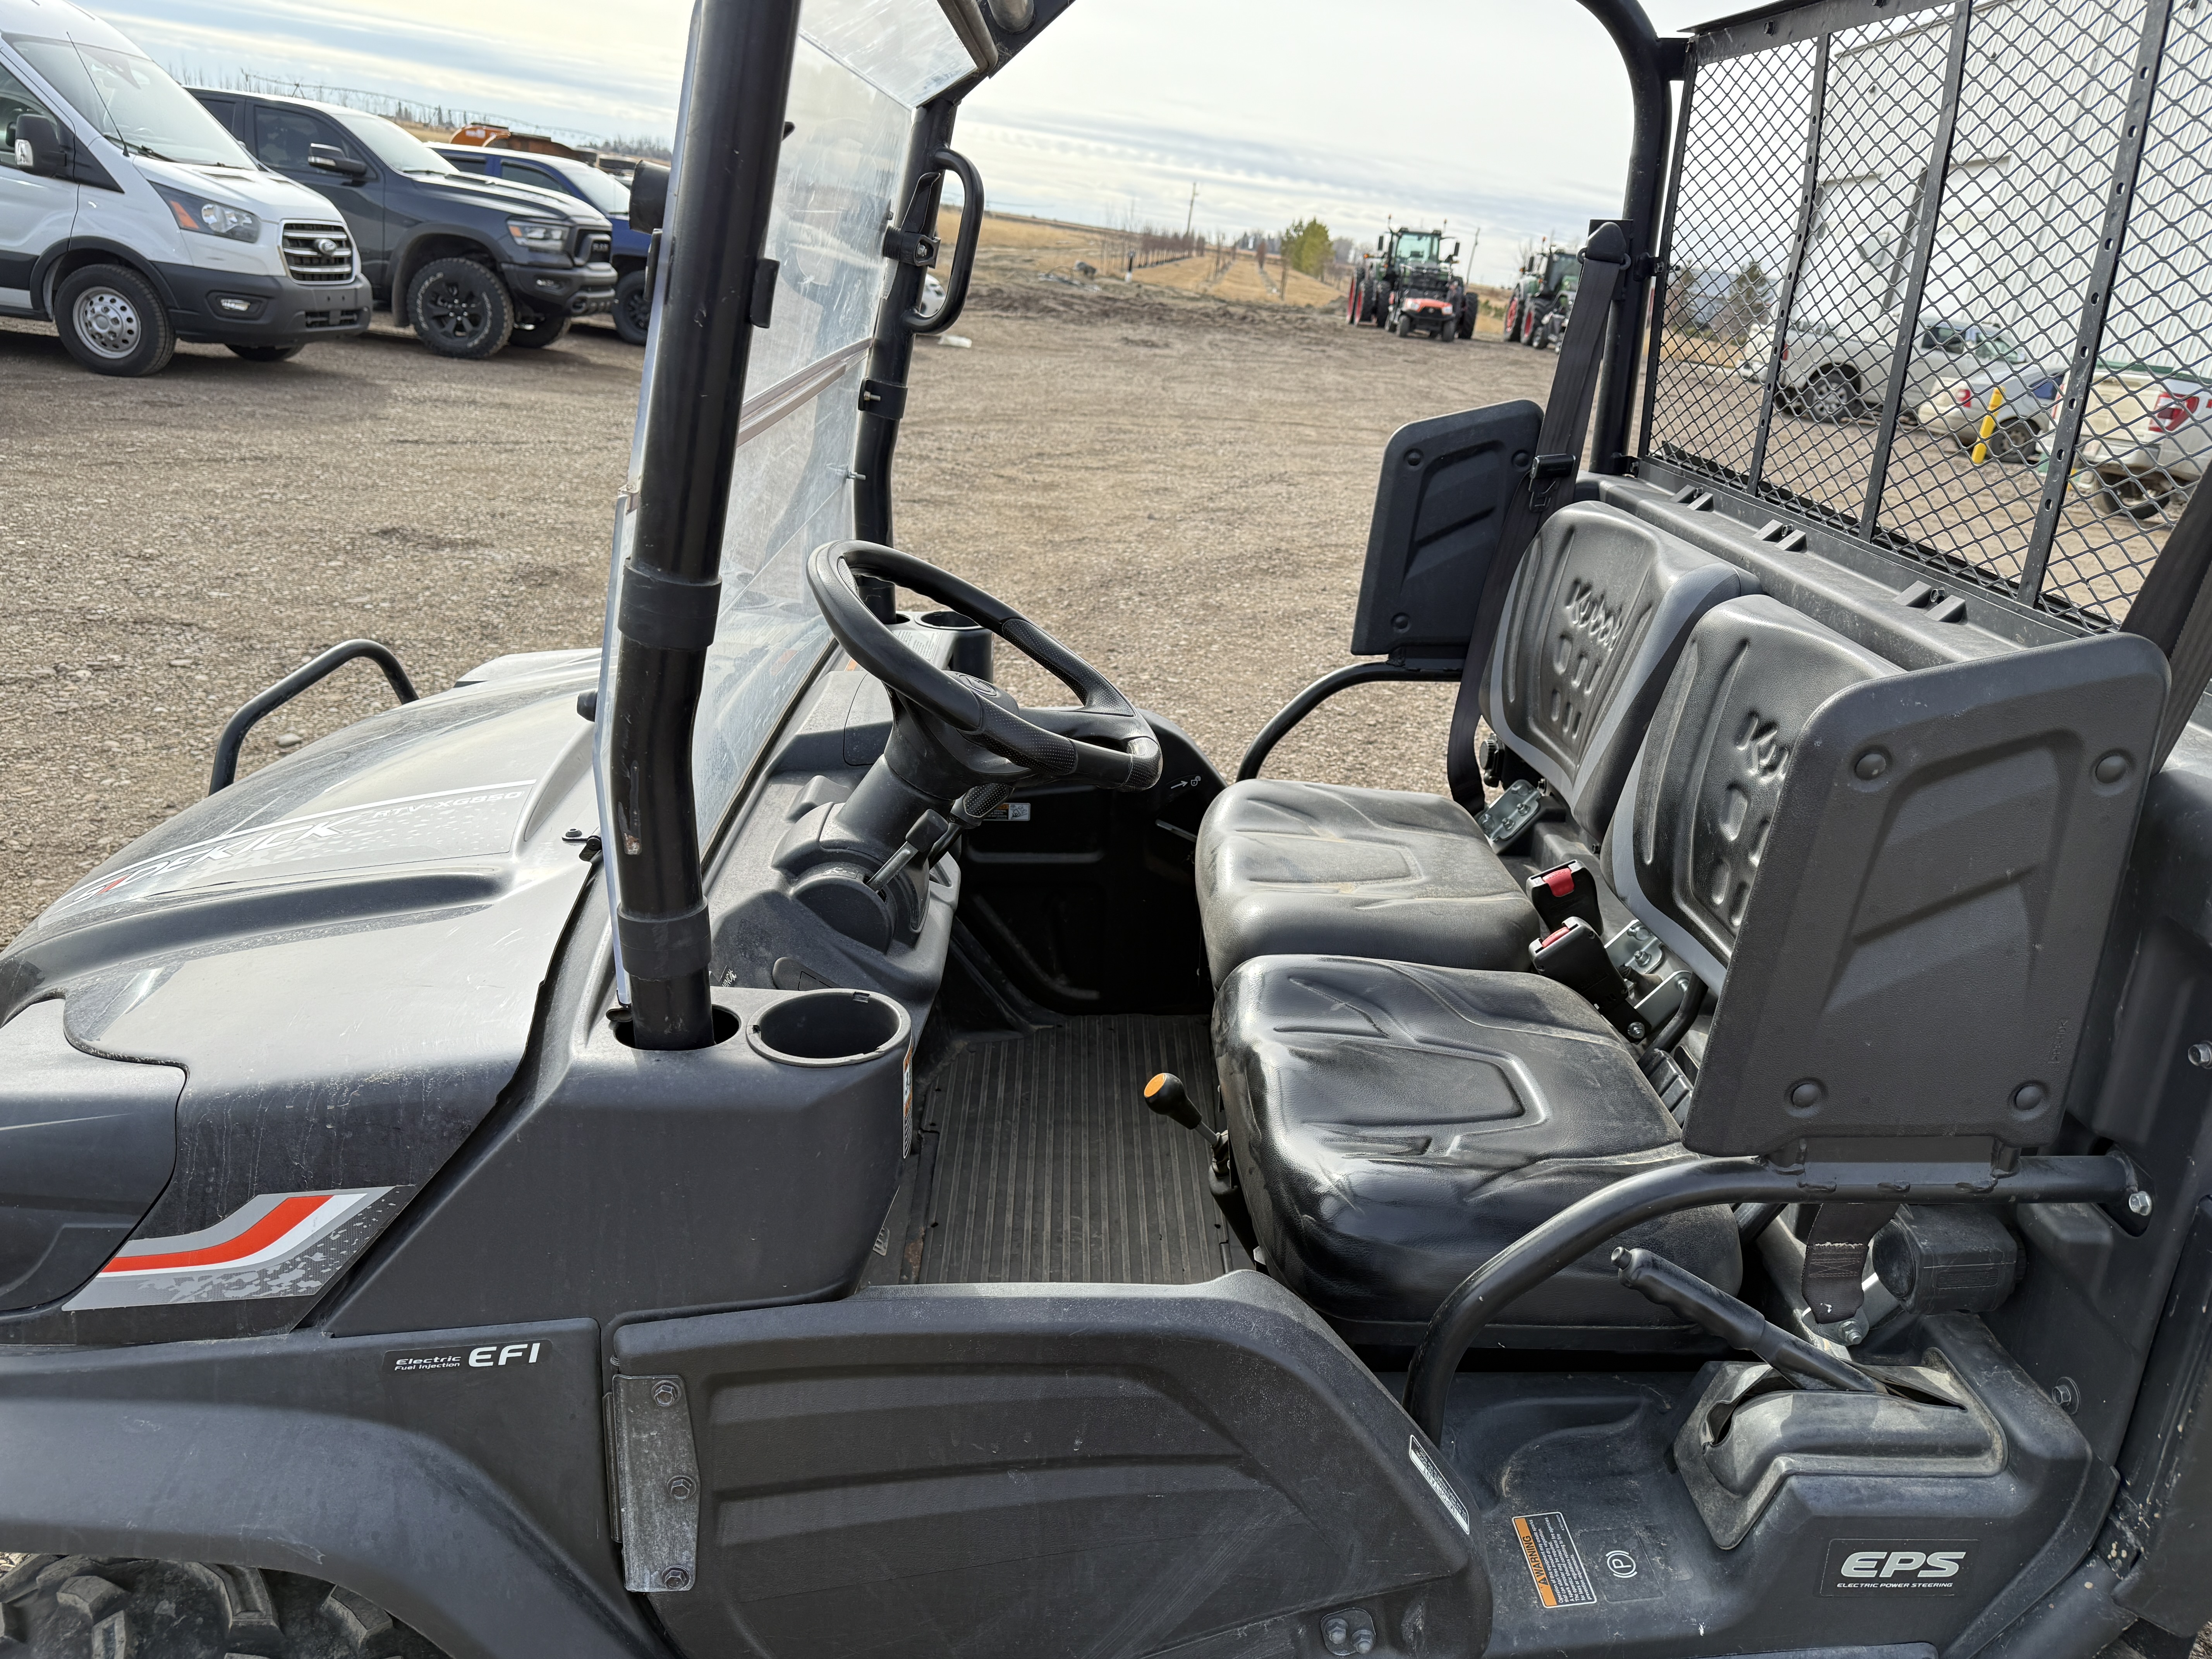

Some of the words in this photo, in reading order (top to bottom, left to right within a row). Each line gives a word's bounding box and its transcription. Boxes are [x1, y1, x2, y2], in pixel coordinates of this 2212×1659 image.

[1564, 578, 1624, 651] Kubota
[373, 791, 524, 819] RTV-XG850
[53, 814, 363, 914] SIDEKICK
[396, 1356, 461, 1365] Electric
[469, 1343, 540, 1367] EFI
[419, 1362, 460, 1370] Injection
[1423, 1465, 1457, 1518] IMPORTANT
[1528, 1519, 1537, 1531] sparks
[1543, 1517, 1554, 1533] agencies
[1522, 1535, 1545, 1577] WARNING
[1556, 1549, 1565, 1563] contact
[1560, 1544, 1570, 1558] relating
[1540, 1551, 1552, 1571] equipment
[1547, 1554, 1556, 1568] around
[1561, 1563, 1570, 1576] should
[1565, 1558, 1578, 1580] regulations
[1841, 1552, 1966, 1578] EPS
[1559, 1571, 1568, 1586] arrester
[1567, 1577, 1578, 1592] operator
[1552, 1584, 1565, 1603] Operation
[1565, 1587, 1574, 1597] spark
[1579, 1580, 1592, 1600] prevention
